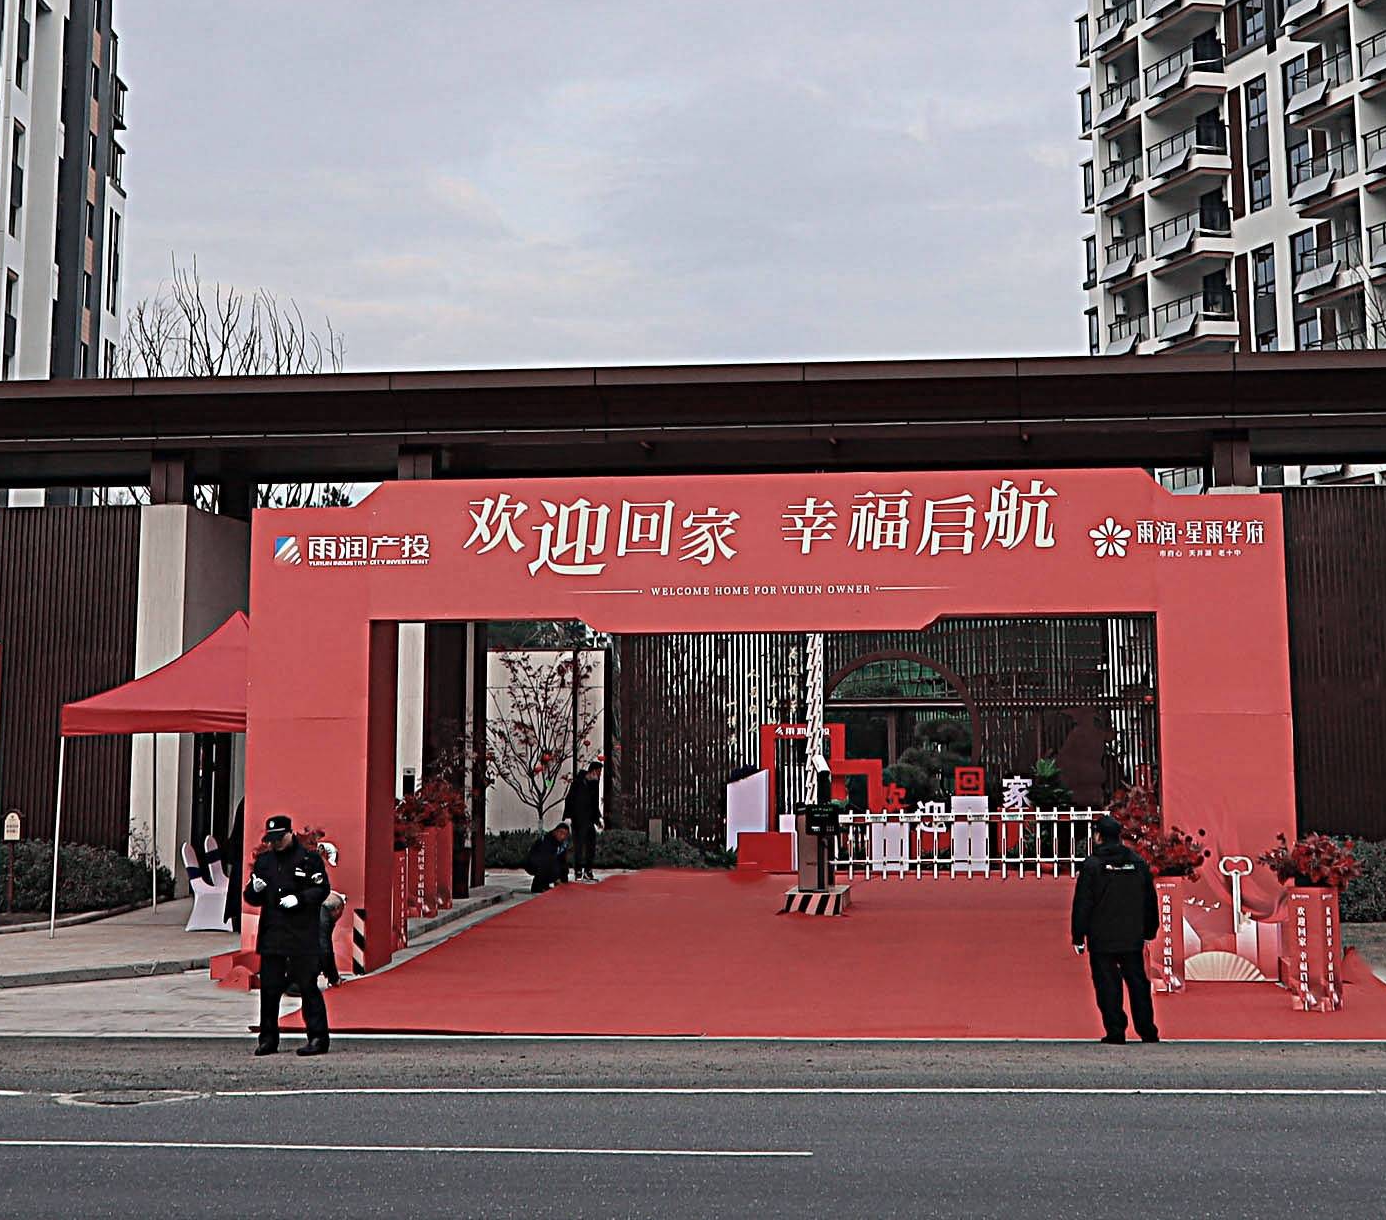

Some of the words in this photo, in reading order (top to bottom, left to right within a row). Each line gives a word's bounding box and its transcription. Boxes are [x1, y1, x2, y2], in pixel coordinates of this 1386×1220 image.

[463, 493, 741, 577] 欢迎回家
[781, 479, 1058, 556] 幸福启航
[308, 535, 430, 560] 雨润产投
[651, 587, 710, 596] WELCOME
[715, 586, 749, 595] HOME
[754, 586, 777, 595] FOR
[782, 585, 822, 594] YURUN
[827, 585, 871, 594] OWNER
